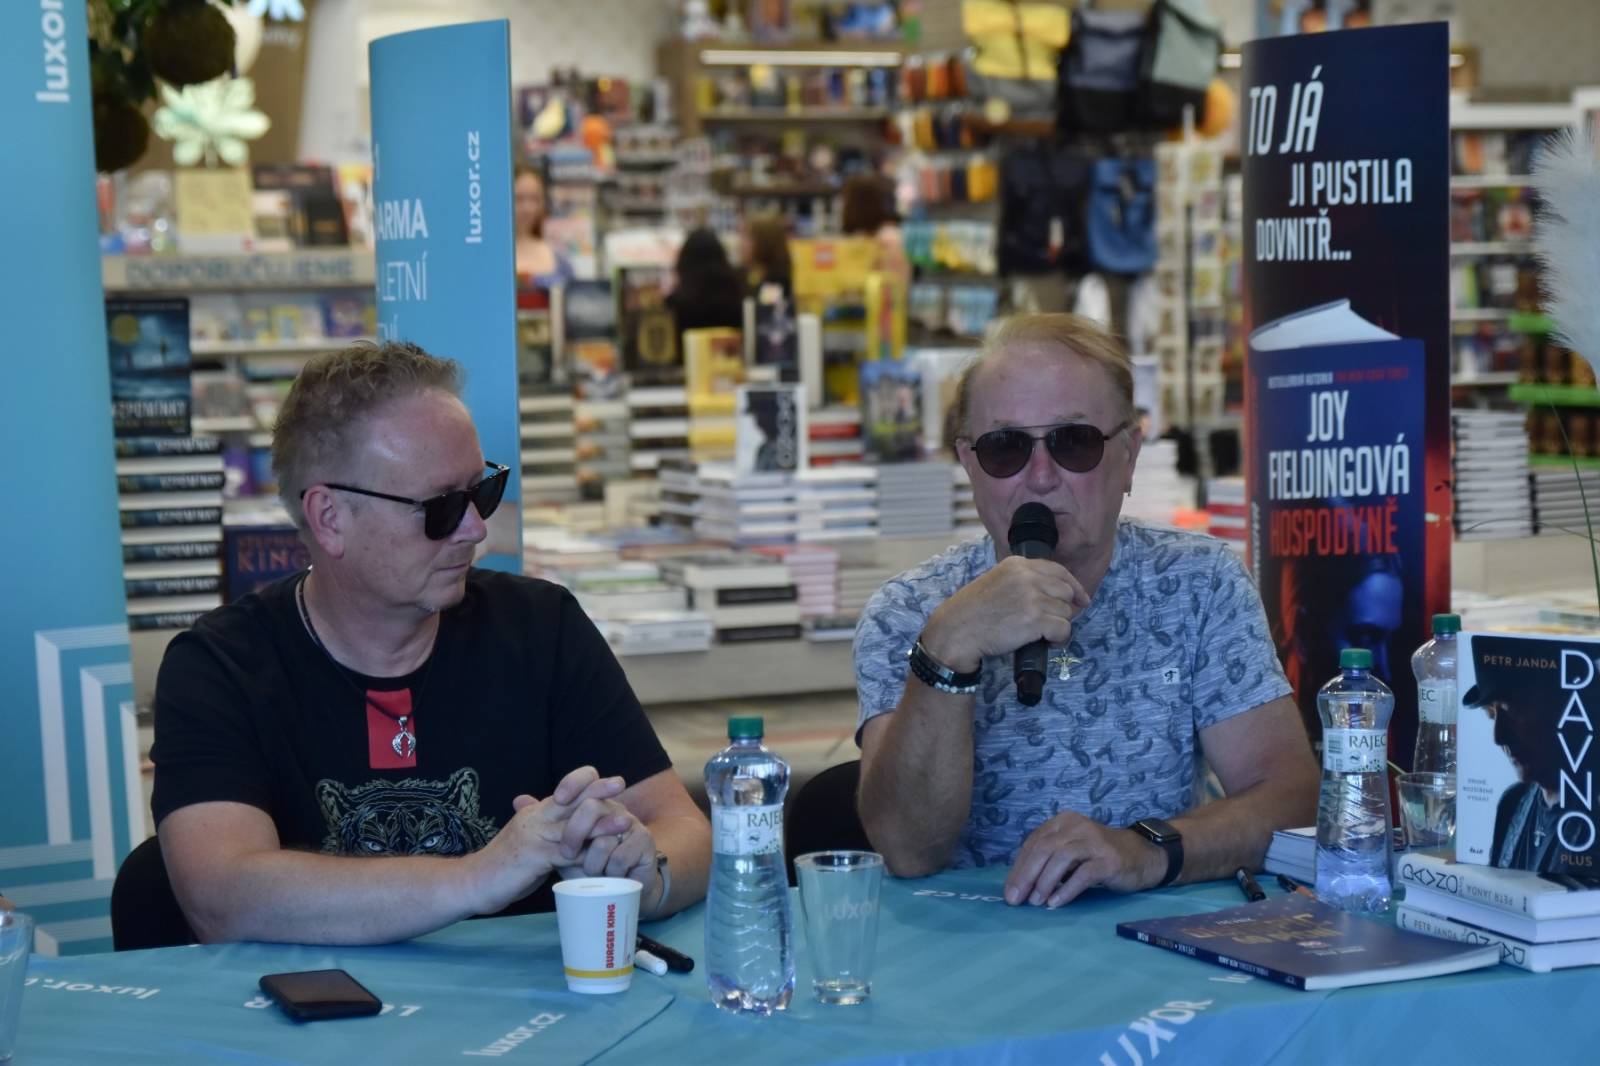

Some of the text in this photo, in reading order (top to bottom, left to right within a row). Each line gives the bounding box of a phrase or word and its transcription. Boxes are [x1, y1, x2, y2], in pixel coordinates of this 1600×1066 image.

[1249, 65, 1324, 155] TO JÁ
[465, 131, 482, 243] luxor.cz
[1289, 158, 1413, 206] JI PUSTILA
[1256, 209, 1351, 261] DOVNITŘ...
[1306, 390, 1349, 442] JOY
[1268, 433, 1410, 500] FIELDINGOVÁ
[1270, 498, 1399, 557] HOSPODYNĚ
[1483, 655, 1558, 669] PETR JANDA
[1560, 853, 1593, 867] PLUS
[606, 903, 617, 969] BURGER KING
[461, 1012, 567, 1057] luxor.cz
